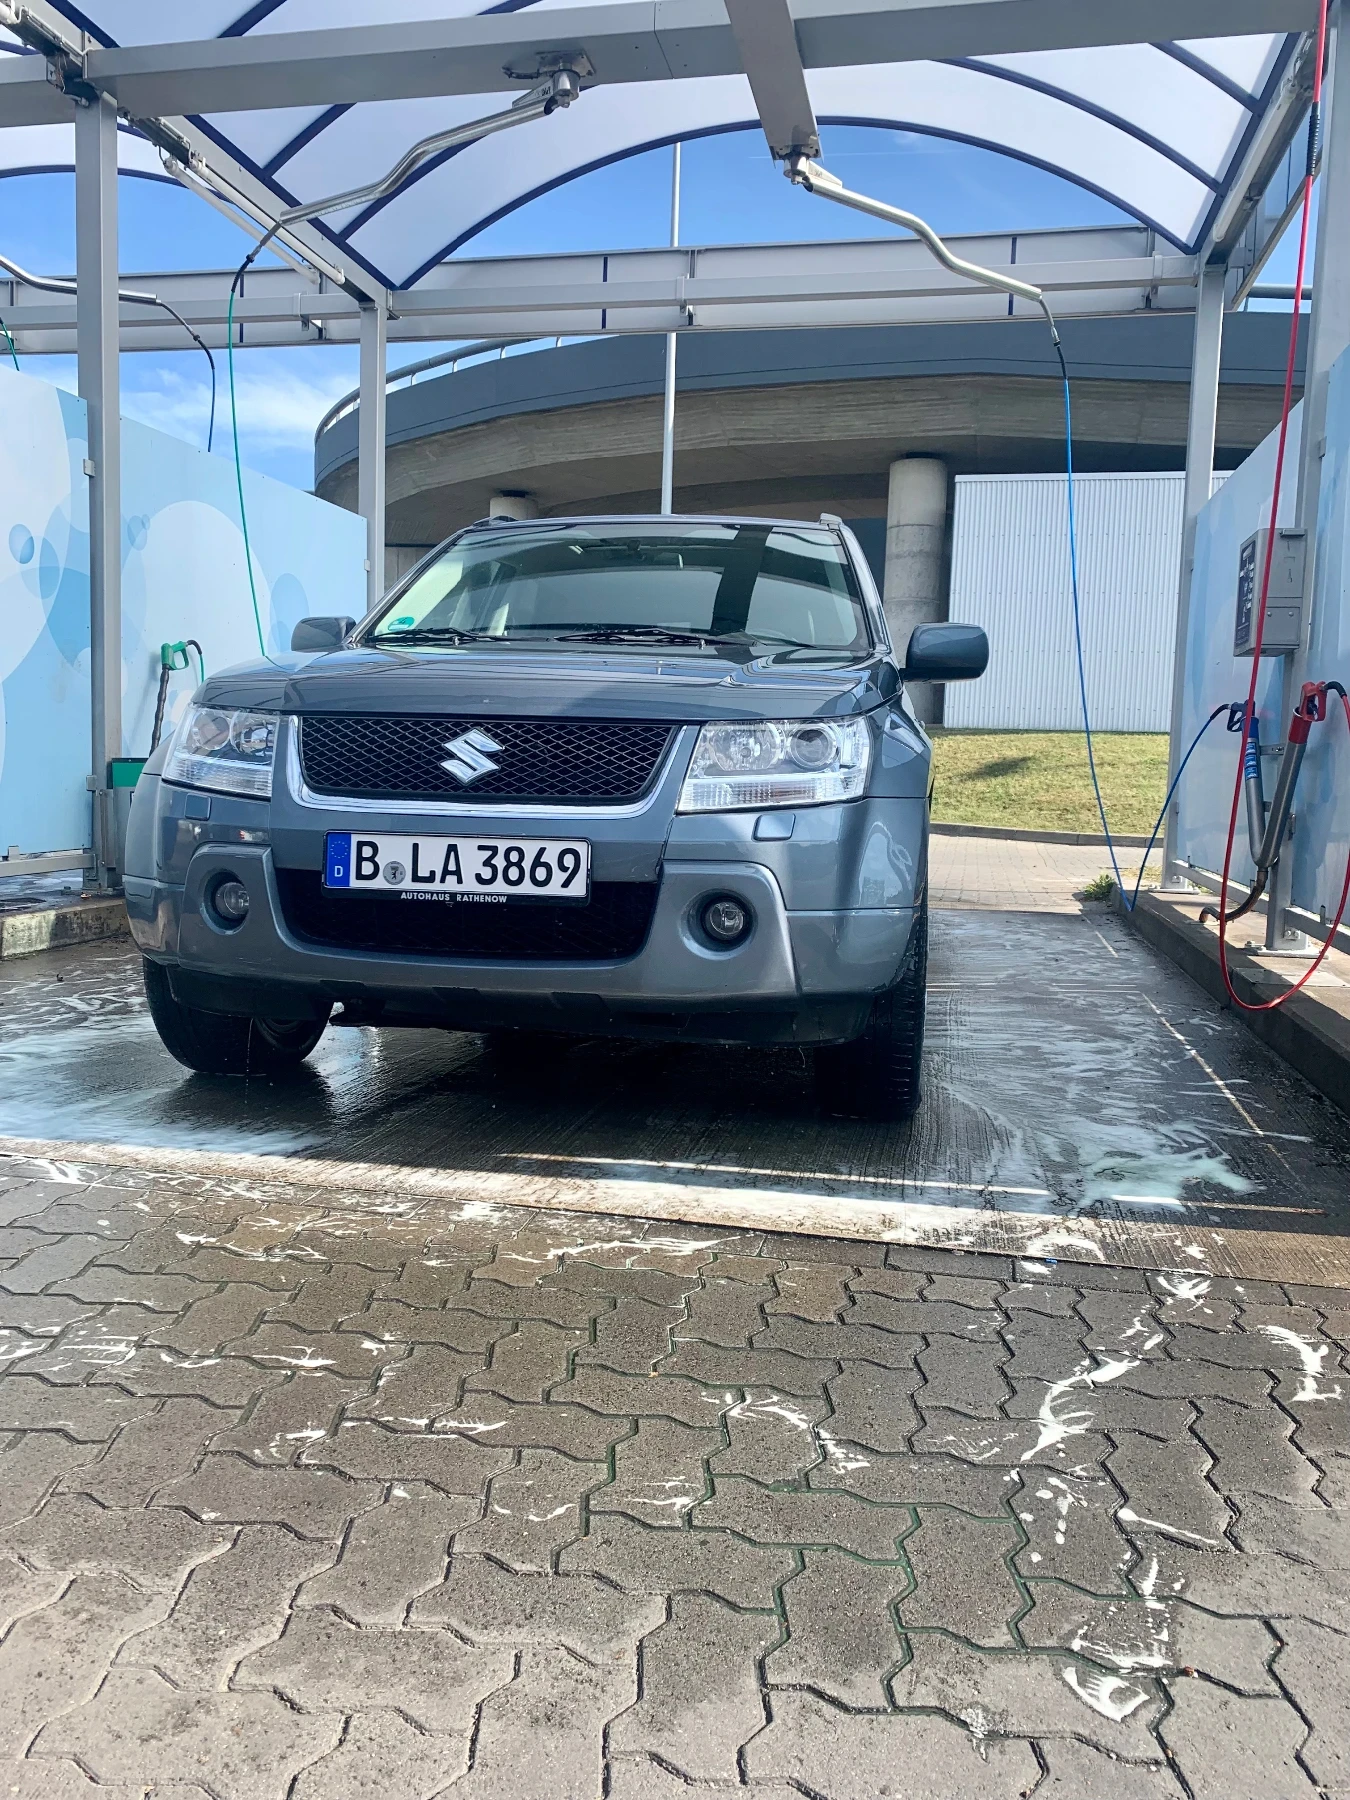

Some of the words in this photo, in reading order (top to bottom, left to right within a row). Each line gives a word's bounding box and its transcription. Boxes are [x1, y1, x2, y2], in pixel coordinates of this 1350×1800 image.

[355, 840, 380, 881] B
[411, 842, 463, 885] LA
[475, 844, 581, 889] 3869
[334, 865, 344, 878] D
[400, 891, 451, 902] AUTOHAUS
[456, 893, 508, 904] RATHENOW
